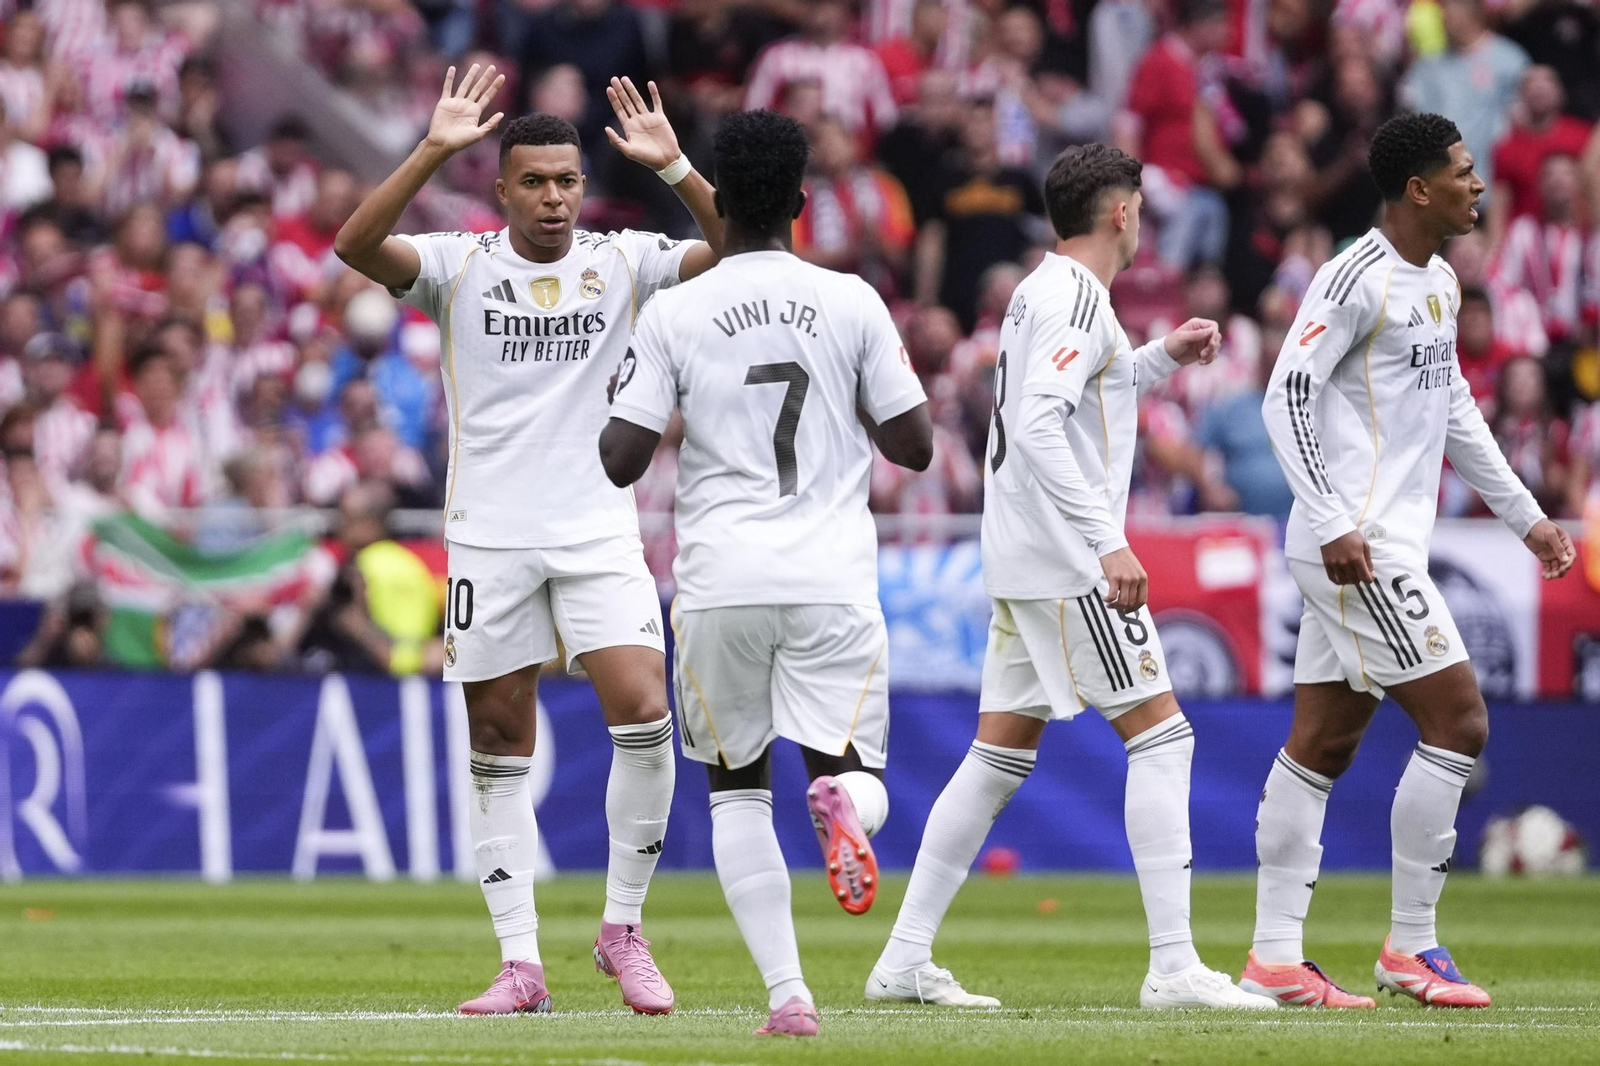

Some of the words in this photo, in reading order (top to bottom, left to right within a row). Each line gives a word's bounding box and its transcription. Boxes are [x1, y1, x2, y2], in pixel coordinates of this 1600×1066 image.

[484, 309, 606, 337] Emirates
[712, 299, 770, 338] VINI
[780, 299, 818, 338] JR.
[501, 341, 529, 362] FLY
[534, 339, 590, 362] BETTER
[743, 361, 810, 498] 7
[446, 577, 474, 631] 10
[1391, 572, 1430, 620] 5
[1116, 608, 1149, 646] 8
